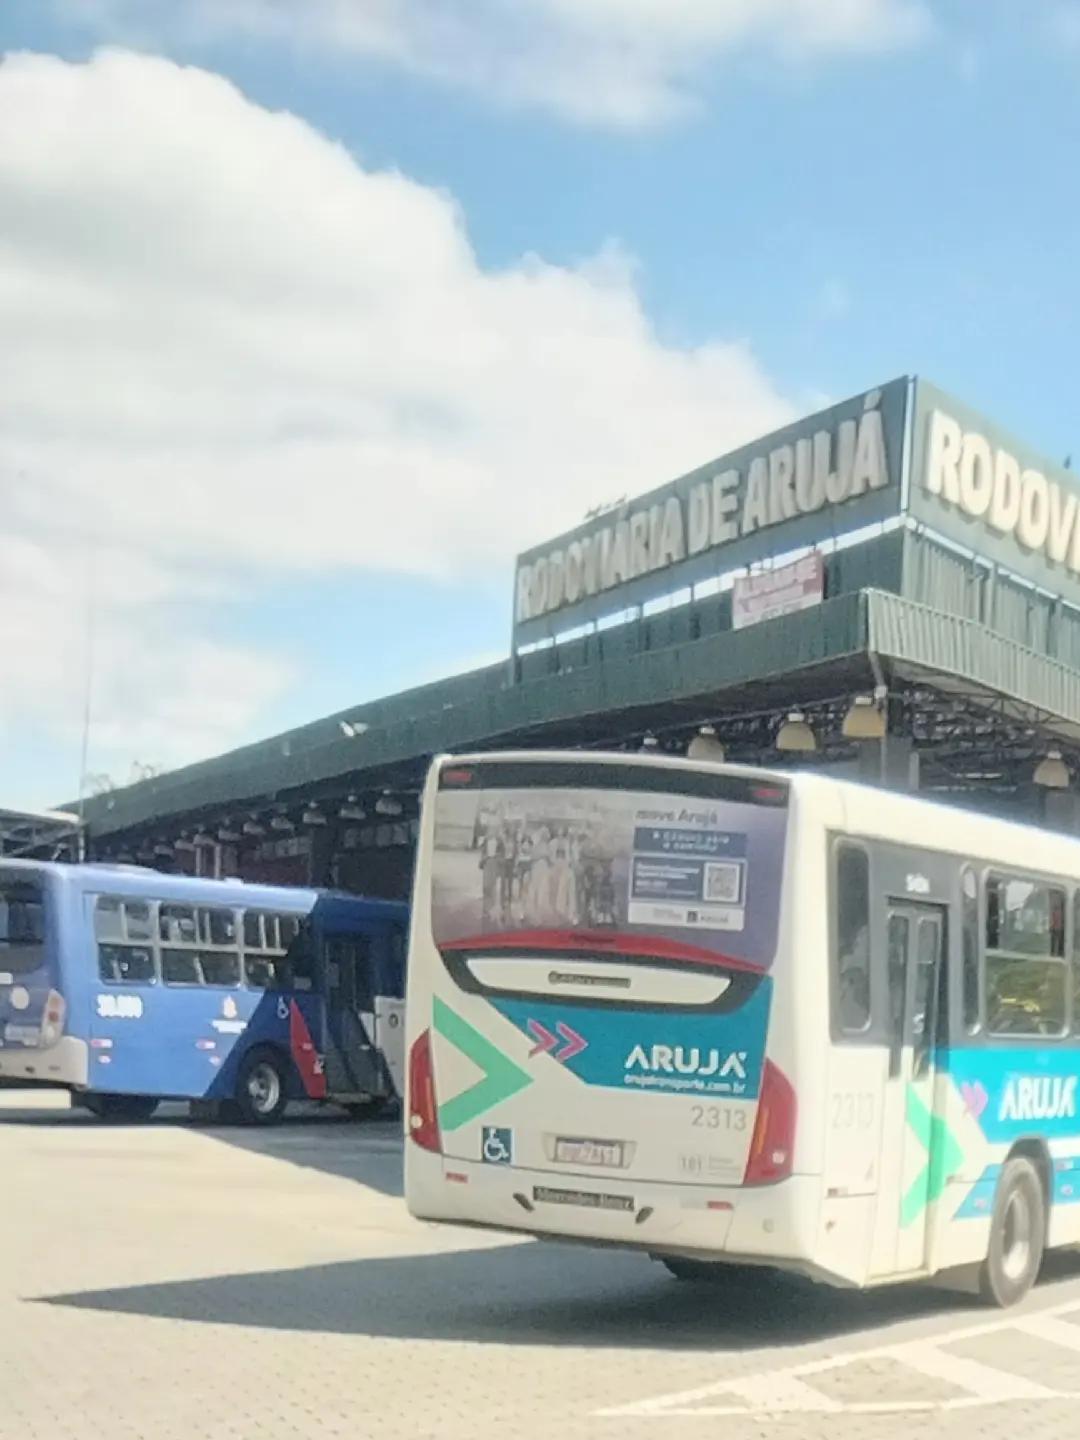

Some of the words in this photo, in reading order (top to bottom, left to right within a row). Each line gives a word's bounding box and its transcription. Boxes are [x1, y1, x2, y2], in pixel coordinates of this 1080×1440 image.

[518, 503, 685, 622] RODOVIÁRIA
[689, 469, 741, 553] DE
[742, 388, 890, 535] ARUJÁ
[624, 1044, 747, 1079] ARUJÁ
[690, 1105, 748, 1133] 2313
[999, 1075, 1078, 1122] ARUJÁ
